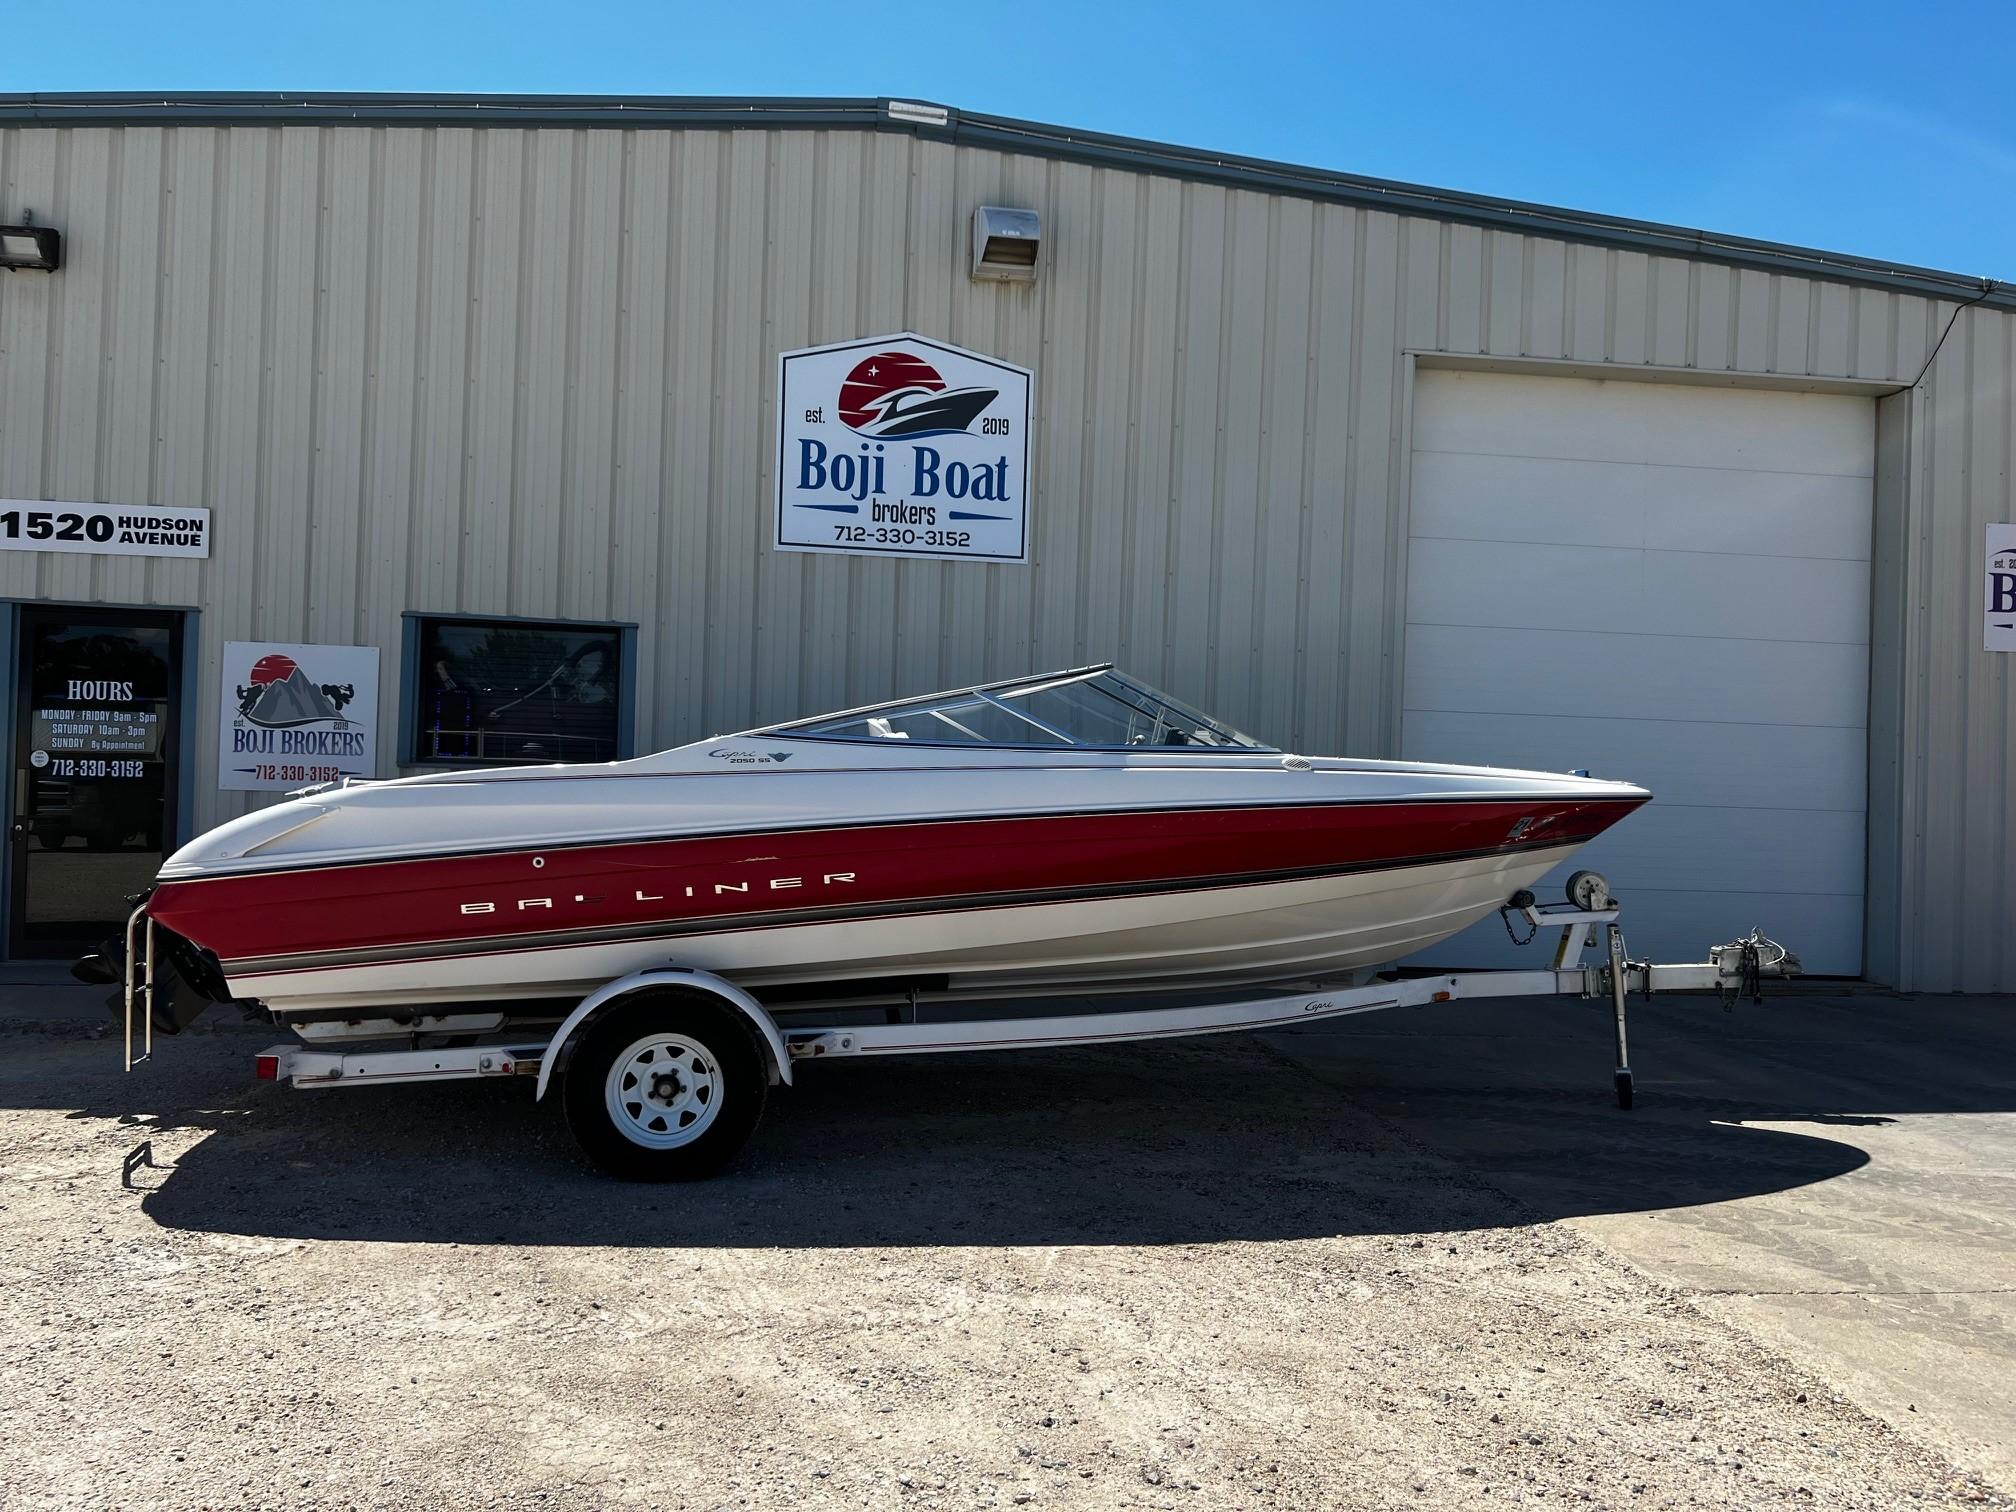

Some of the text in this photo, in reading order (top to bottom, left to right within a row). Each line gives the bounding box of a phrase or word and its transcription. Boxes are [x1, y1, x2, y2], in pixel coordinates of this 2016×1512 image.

[805, 407, 826, 424] est.
[982, 418, 1010, 436] 2019
[796, 438, 1012, 502] Boji Boat
[872, 498, 936, 526] brokers
[0, 511, 204, 543] 1520 HUDSON
[119, 531, 201, 547] AVENUE
[834, 526, 971, 548] 712-330-3152
[67, 680, 133, 701] HOURS
[41, 709, 76, 720] MONDAY
[82, 711, 110, 721] FRIDAY
[113, 712, 132, 722] 9am
[233, 720, 246, 728] est.
[52, 724, 94, 735] SATURDAY
[99, 725, 120, 736] 10am
[127, 726, 146, 737] 3pm
[333, 721, 349, 731] 2019
[51, 738, 84, 748] SUNDAY
[232, 728, 365, 757] BOJI BROKERS
[52, 760, 144, 777] 712-330-3152
[255, 765, 339, 781] 712-330-3152
[1304, 1001, 1335, 1013] Capri
